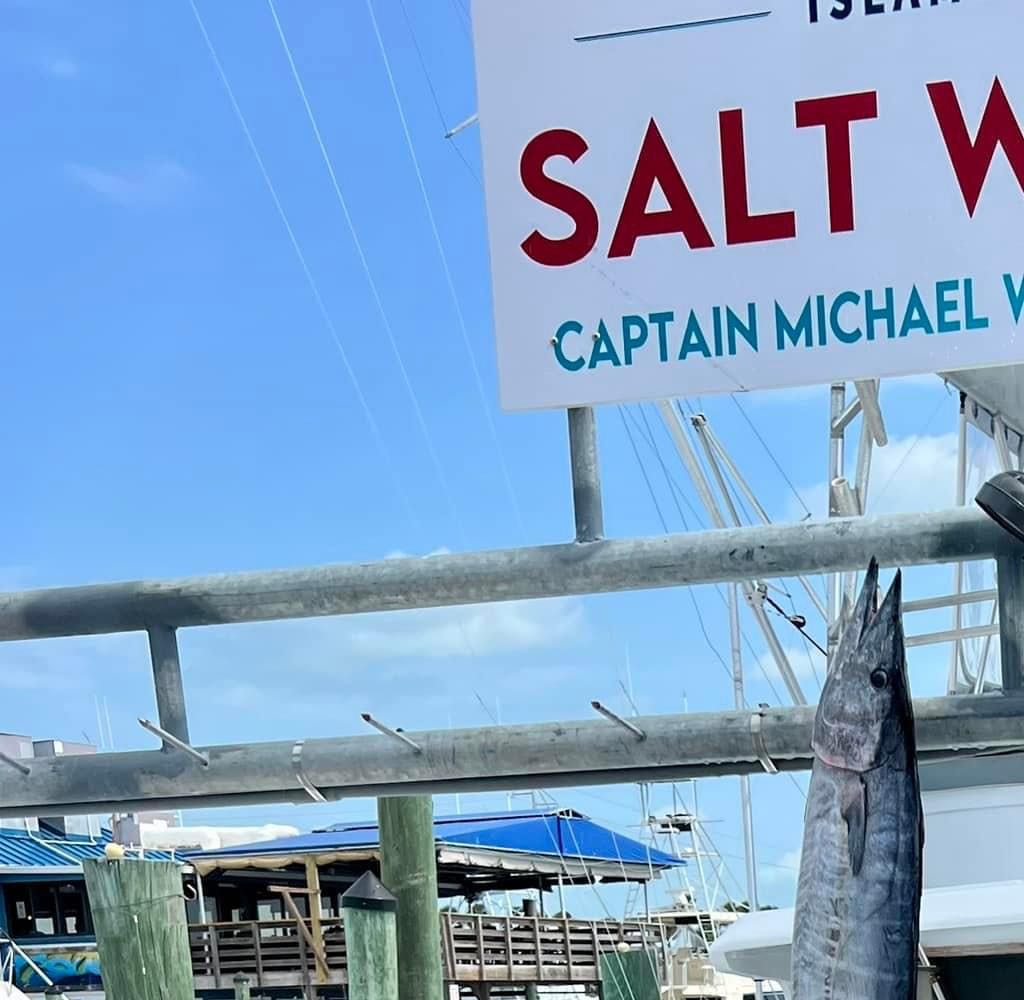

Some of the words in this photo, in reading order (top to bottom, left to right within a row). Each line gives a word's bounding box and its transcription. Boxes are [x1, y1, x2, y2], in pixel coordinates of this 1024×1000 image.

[520, 91, 877, 266] SALT
[552, 302, 758, 372] CAPTAIN
[774, 278, 989, 351] MICHAEL
